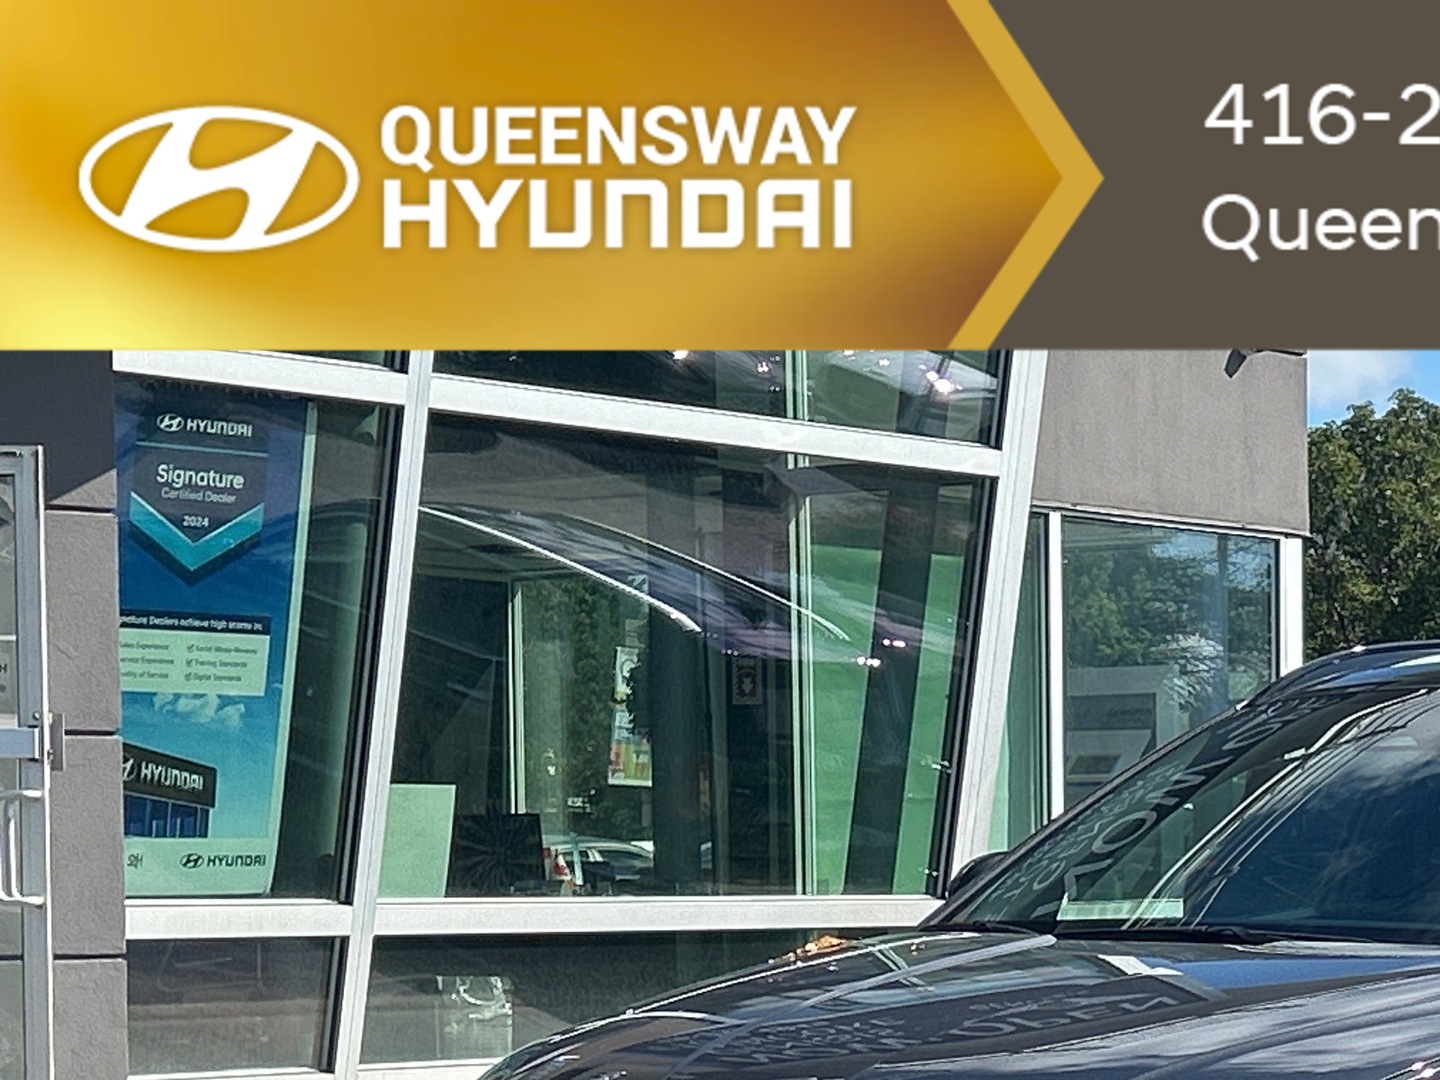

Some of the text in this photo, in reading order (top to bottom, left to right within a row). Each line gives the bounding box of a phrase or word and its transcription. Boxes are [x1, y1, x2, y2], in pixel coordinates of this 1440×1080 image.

[186, 418, 252, 437] HYUNDAI
[156, 464, 245, 489] Signature
[140, 761, 204, 791] HYUNDAI
[206, 854, 266, 867] HYUNDAI
